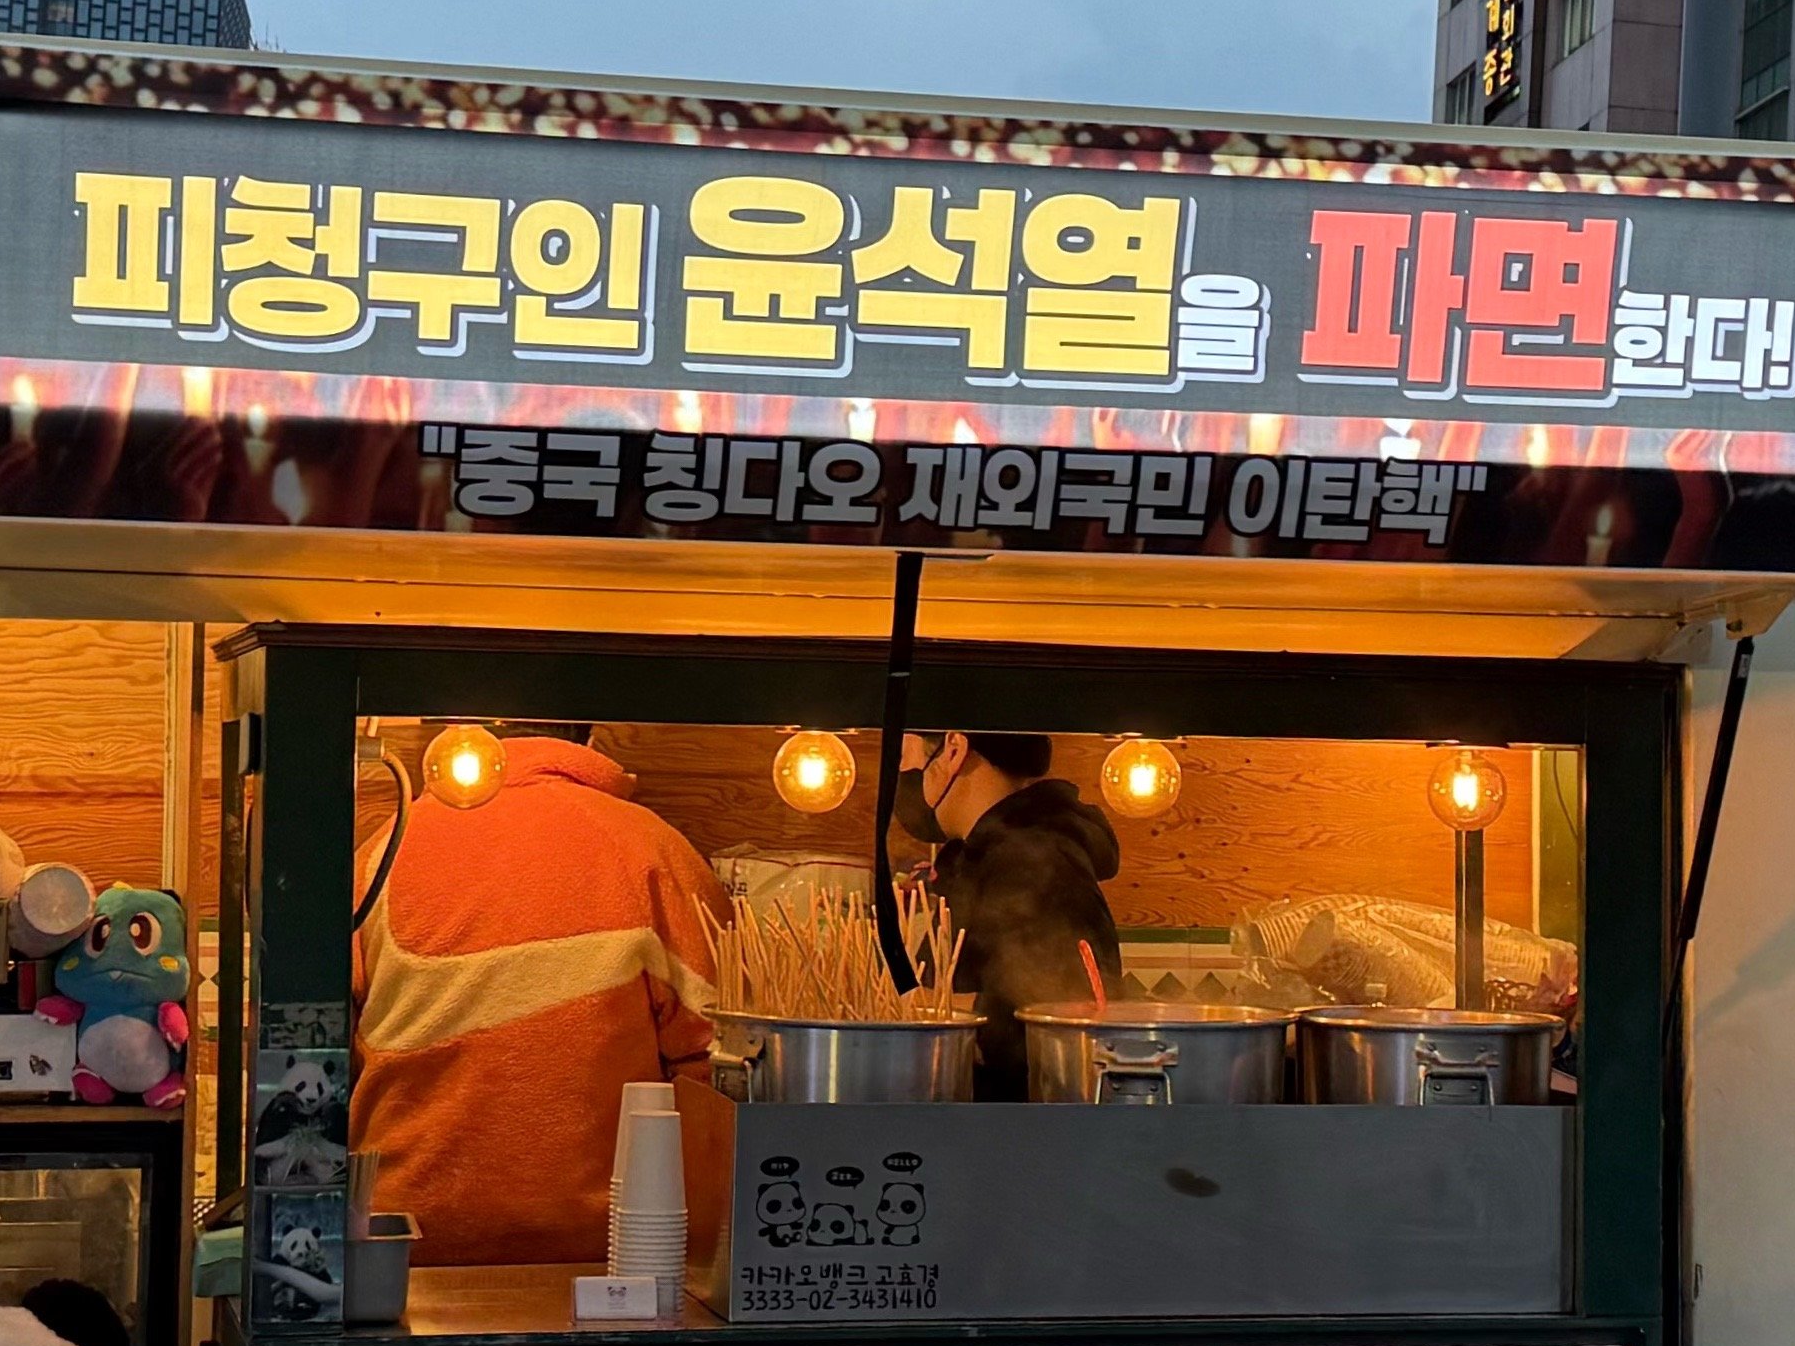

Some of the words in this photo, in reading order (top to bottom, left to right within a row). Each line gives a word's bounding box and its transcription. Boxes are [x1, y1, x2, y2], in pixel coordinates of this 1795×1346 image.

[71, 171, 656, 361] 피청구인
[682, 175, 1268, 391] 윤석열을
[421, 422, 623, 520] "중국
[643, 432, 884, 526] 칭다오
[897, 443, 1206, 537] 재외국민
[1228, 455, 1487, 545] 이탄핵"
[741, 1262, 868, 1290] 카카오뱅크
[875, 1263, 939, 1289] 고효경
[741, 1287, 938, 1311] 3333-02-3431410
